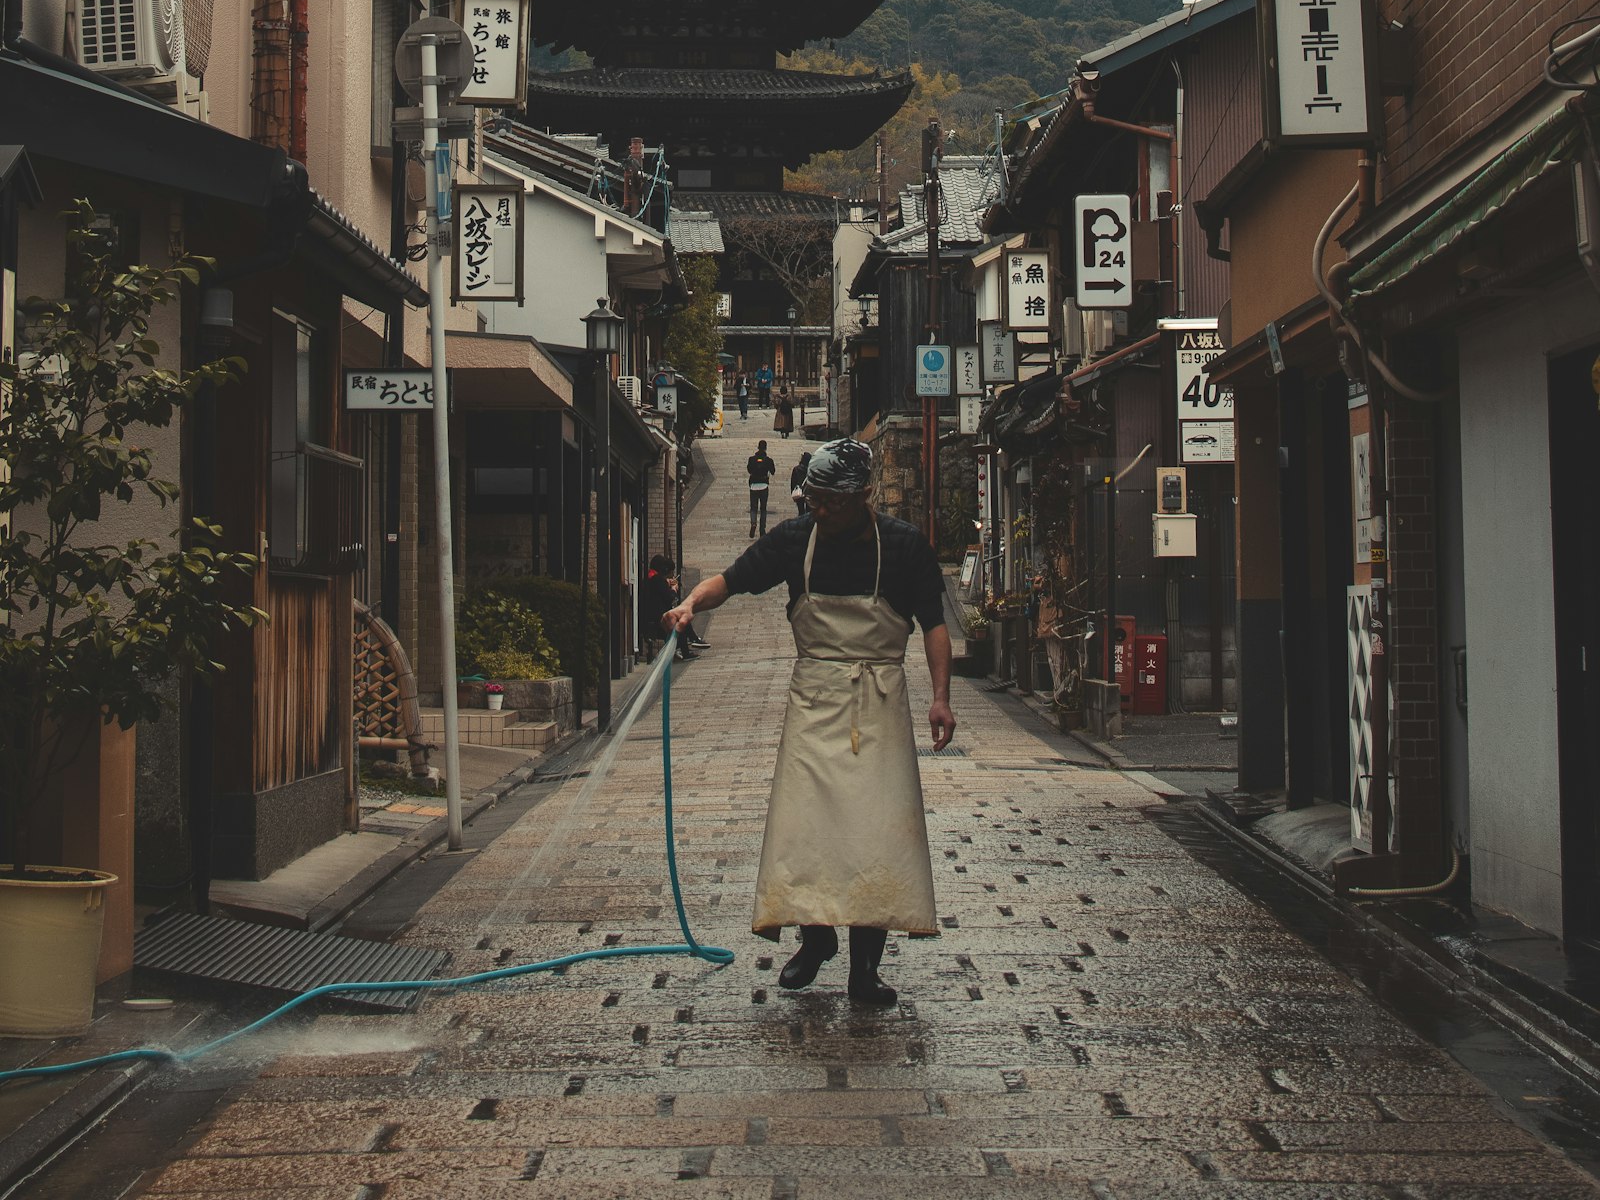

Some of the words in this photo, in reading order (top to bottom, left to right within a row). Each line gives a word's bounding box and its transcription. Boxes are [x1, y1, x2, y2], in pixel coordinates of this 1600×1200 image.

[473, 8, 490, 17] 民宿
[495, 8, 513, 50] 旅館
[472, 22, 489, 84] ちとせ
[464, 196, 492, 290] 八坂ガレージ
[1100, 250, 1126, 268] 24
[1011, 256, 1023, 285] 鮮魚
[1025, 264, 1046, 316] 魚捨
[351, 375, 377, 390] 民宿
[964, 351, 975, 389] なかむら
[1115, 644, 1124, 673] 消火器
[1146, 643, 1157, 685] 消火器
